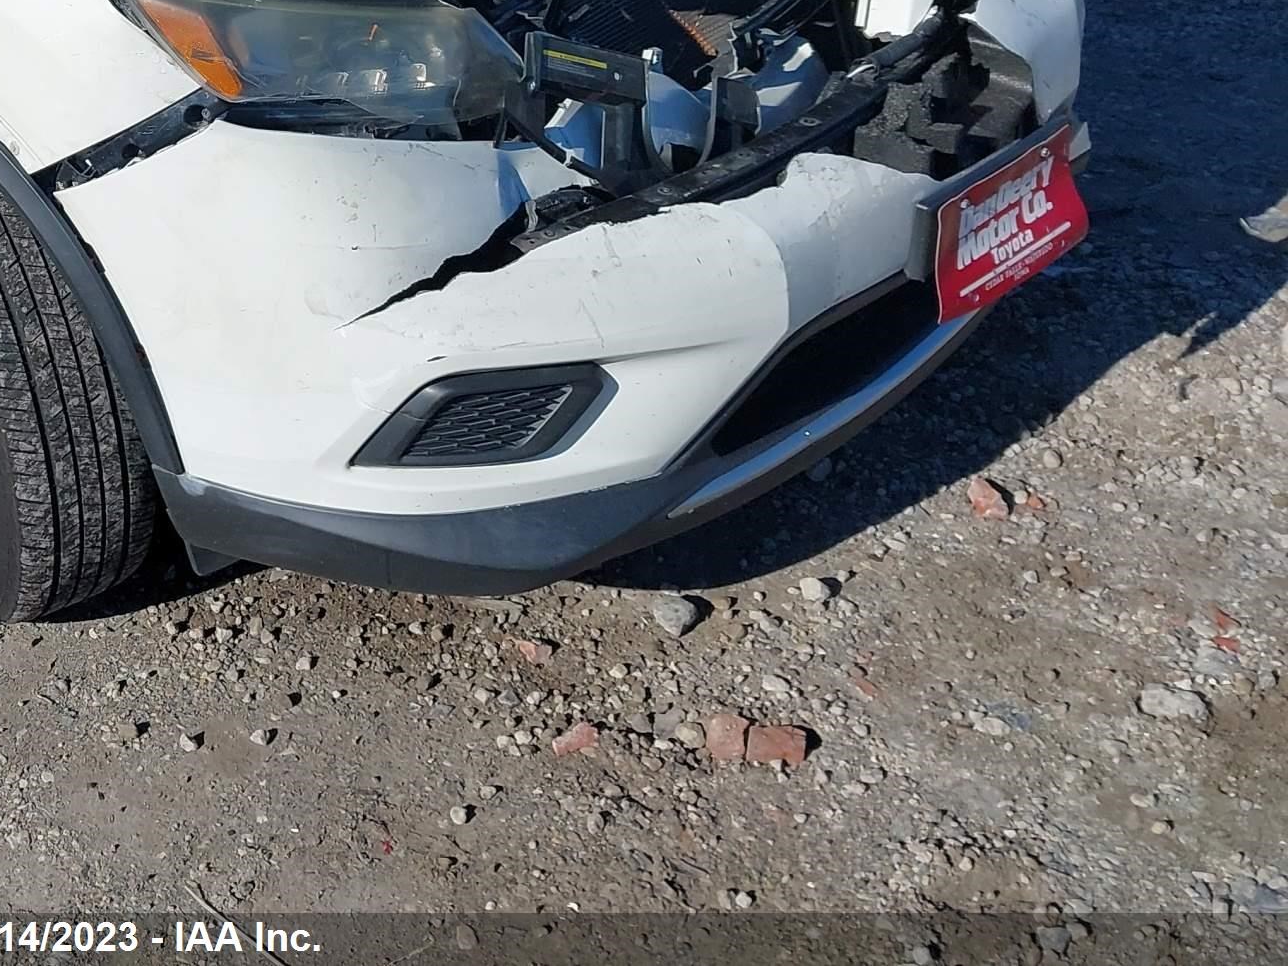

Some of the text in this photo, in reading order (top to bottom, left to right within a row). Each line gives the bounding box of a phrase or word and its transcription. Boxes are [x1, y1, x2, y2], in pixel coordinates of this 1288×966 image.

[957, 189, 1053, 270] Motor Co.
[990, 229, 1035, 265] Toyota
